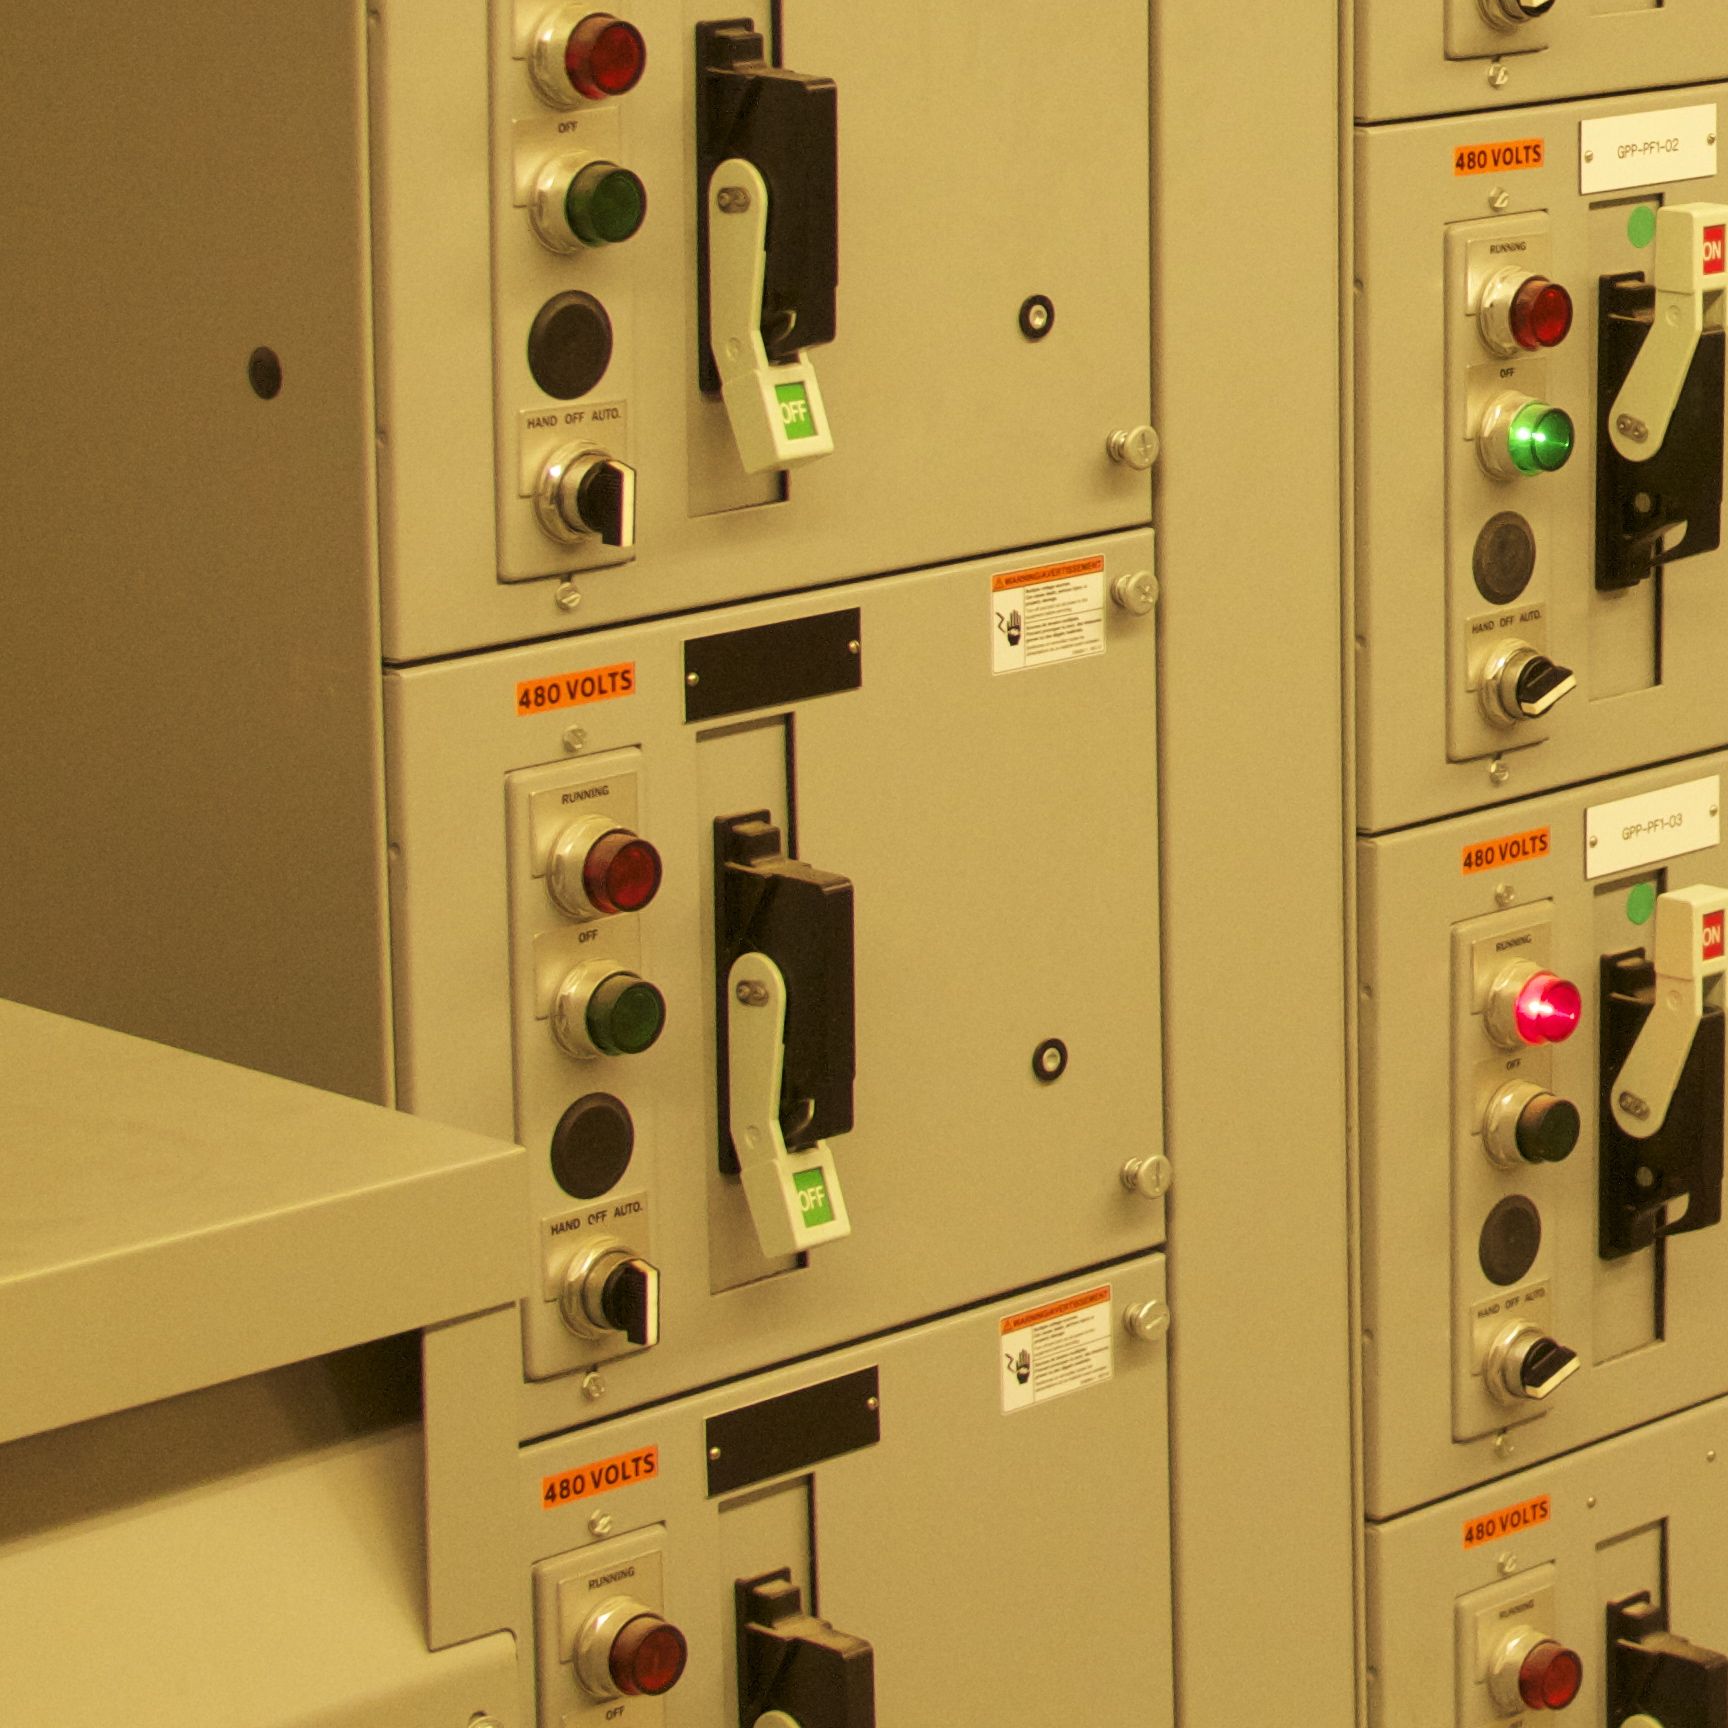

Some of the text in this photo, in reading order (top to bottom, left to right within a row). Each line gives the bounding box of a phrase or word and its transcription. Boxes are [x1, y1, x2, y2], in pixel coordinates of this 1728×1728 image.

[558, 121, 578, 133] OFF
[1455, 144, 1540, 170] 480 VOLTS
[1618, 138, 1678, 159] GPP-PF1-02
[1703, 241, 1721, 260] ON
[528, 415, 557, 428] HAND
[565, 412, 584, 424] OFF
[779, 400, 806, 425] OFF
[519, 669, 630, 710] 480 VOLTS
[562, 786, 609, 804] RUNNING
[1622, 813, 1682, 840] GPP-PF1-03
[1463, 833, 1547, 870] 480 VOLTS
[578, 929, 598, 943] OFF
[1703, 926, 1720, 946] ON
[798, 1186, 825, 1212] OFF
[551, 1214, 582, 1236] HAND
[588, 1207, 608, 1225] OFF
[544, 1452, 654, 1504] 480 VOLTS
[1465, 1499, 1547, 1545] 480 VOLTS
[589, 1566, 635, 1590] RUNNING
[606, 1705, 625, 1721] OFF
